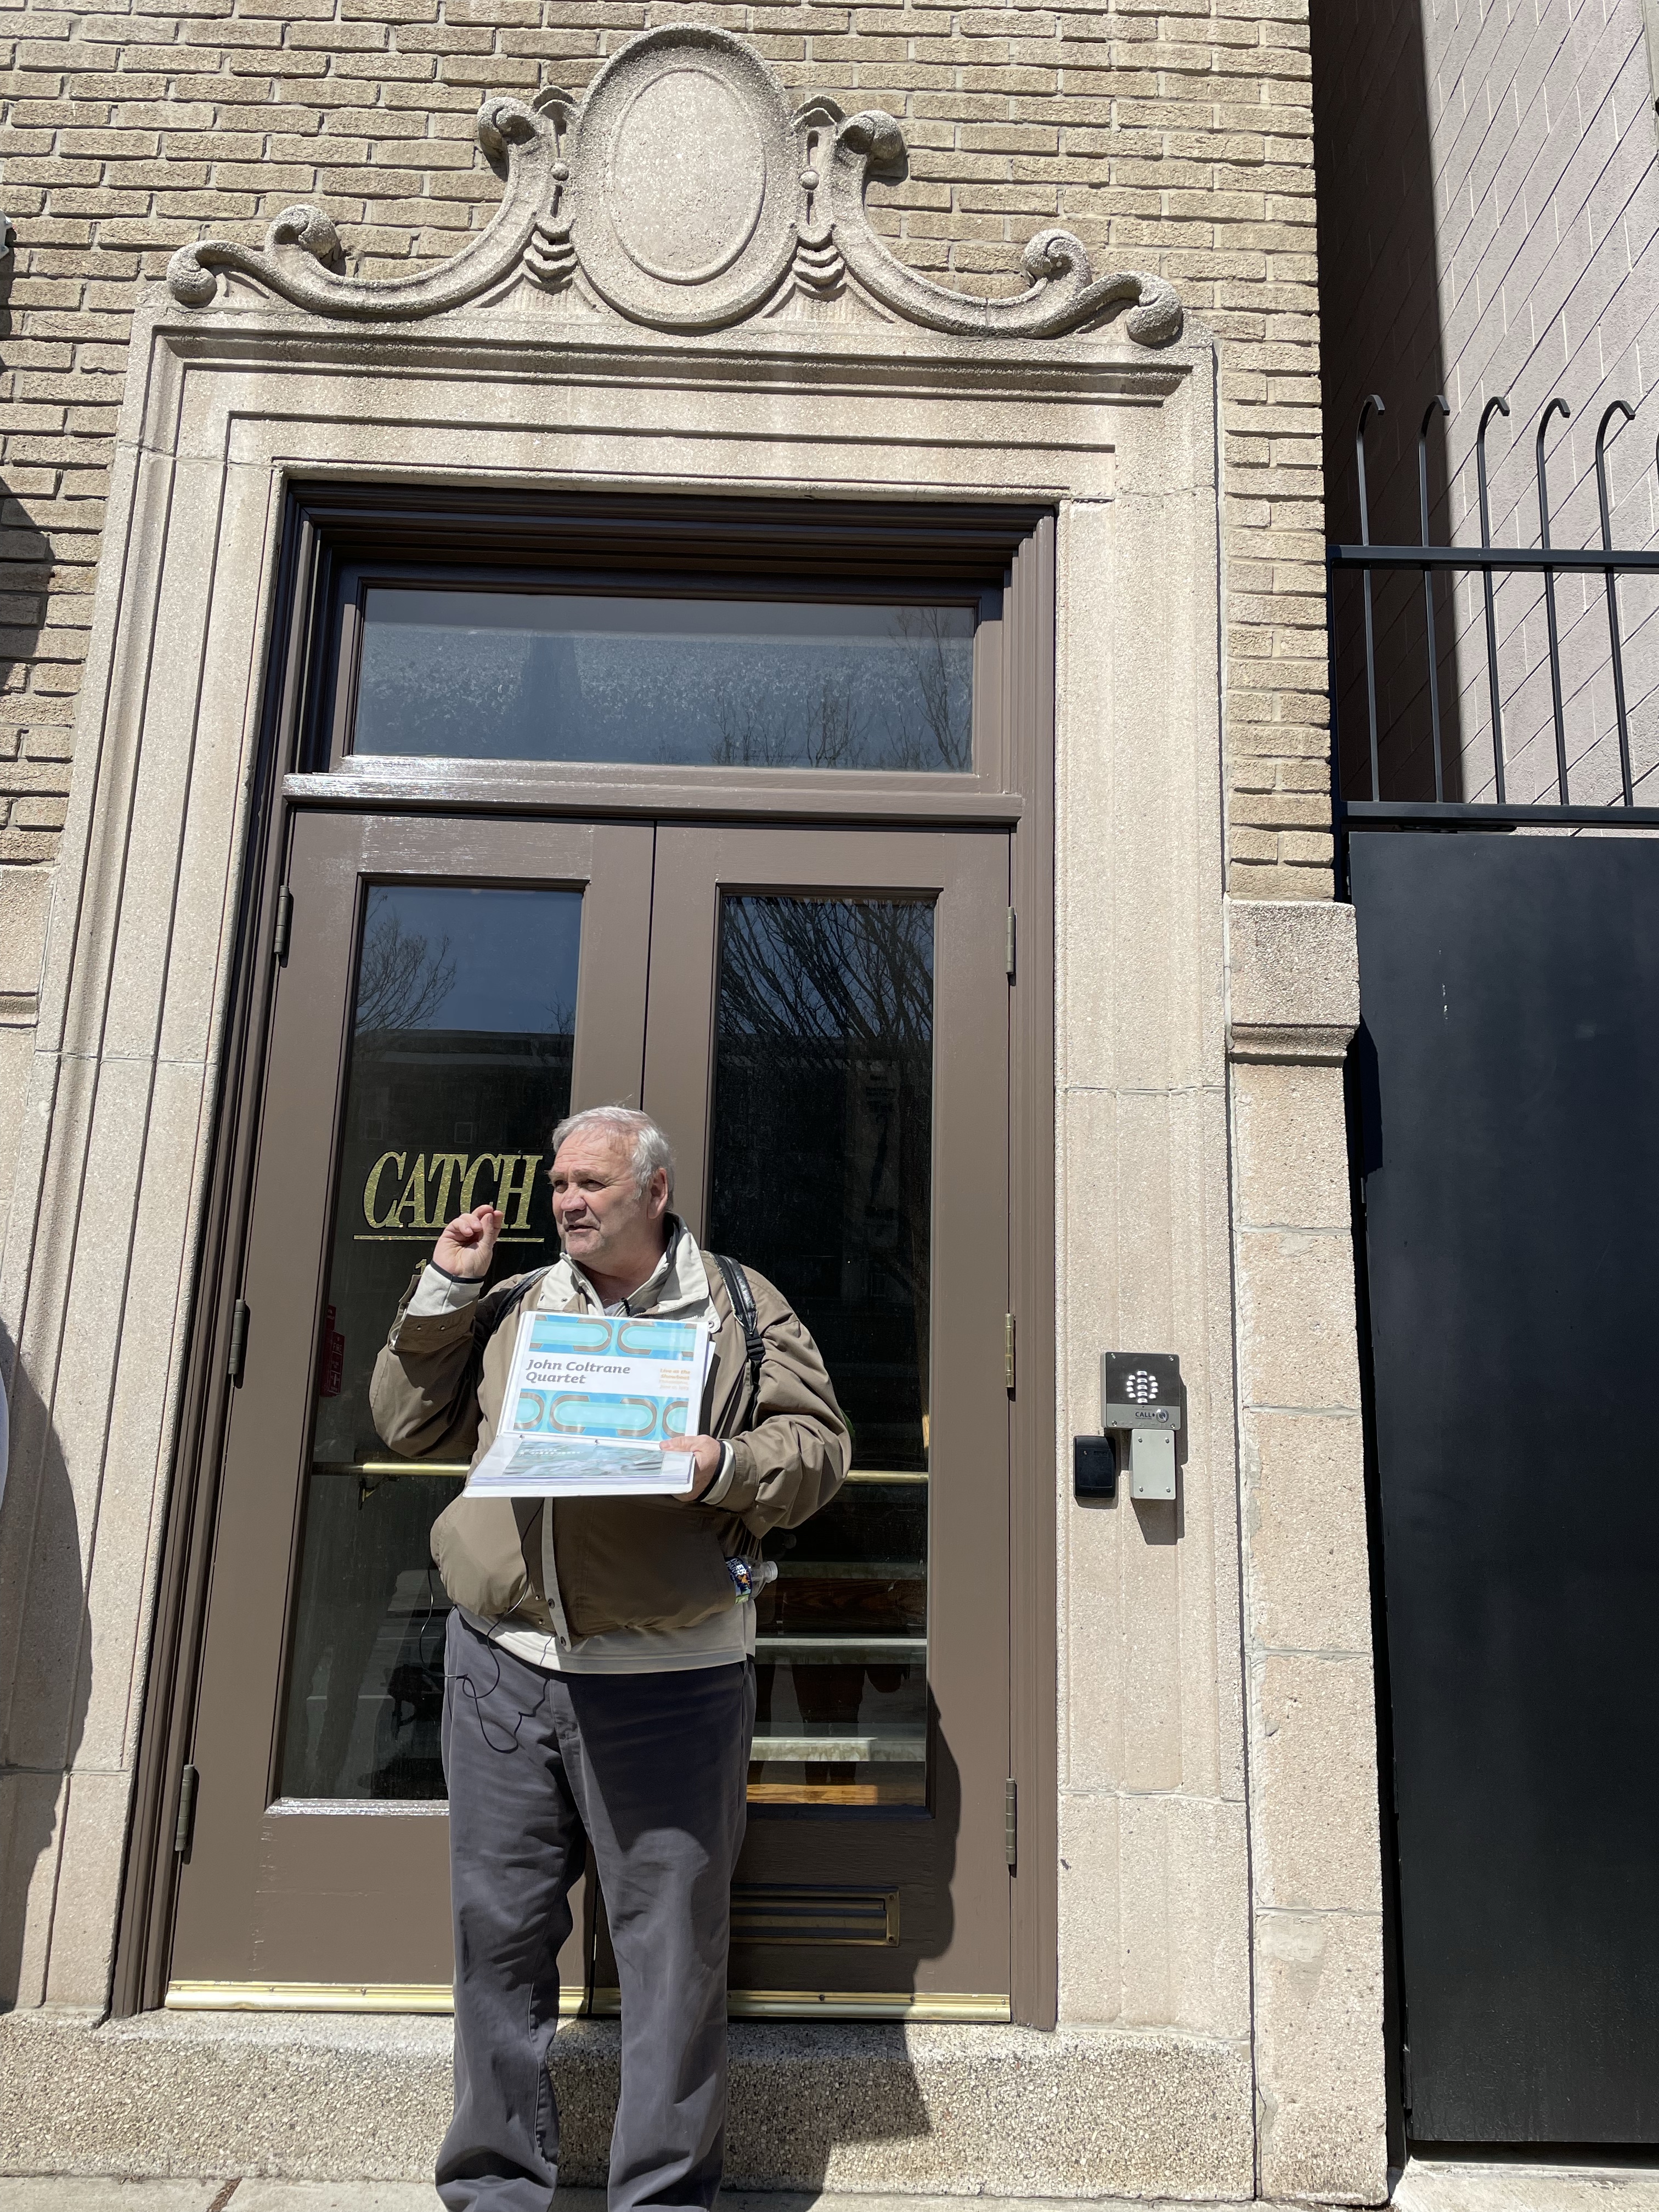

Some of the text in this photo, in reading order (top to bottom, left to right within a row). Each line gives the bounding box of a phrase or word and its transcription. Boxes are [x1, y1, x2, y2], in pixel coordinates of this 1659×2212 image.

[363, 1151, 543, 1229] CATCH
[526, 1359, 631, 1374] John Coltrane
[526, 1372, 586, 1384] Quartet
[730, 1558, 747, 1575] DEER
